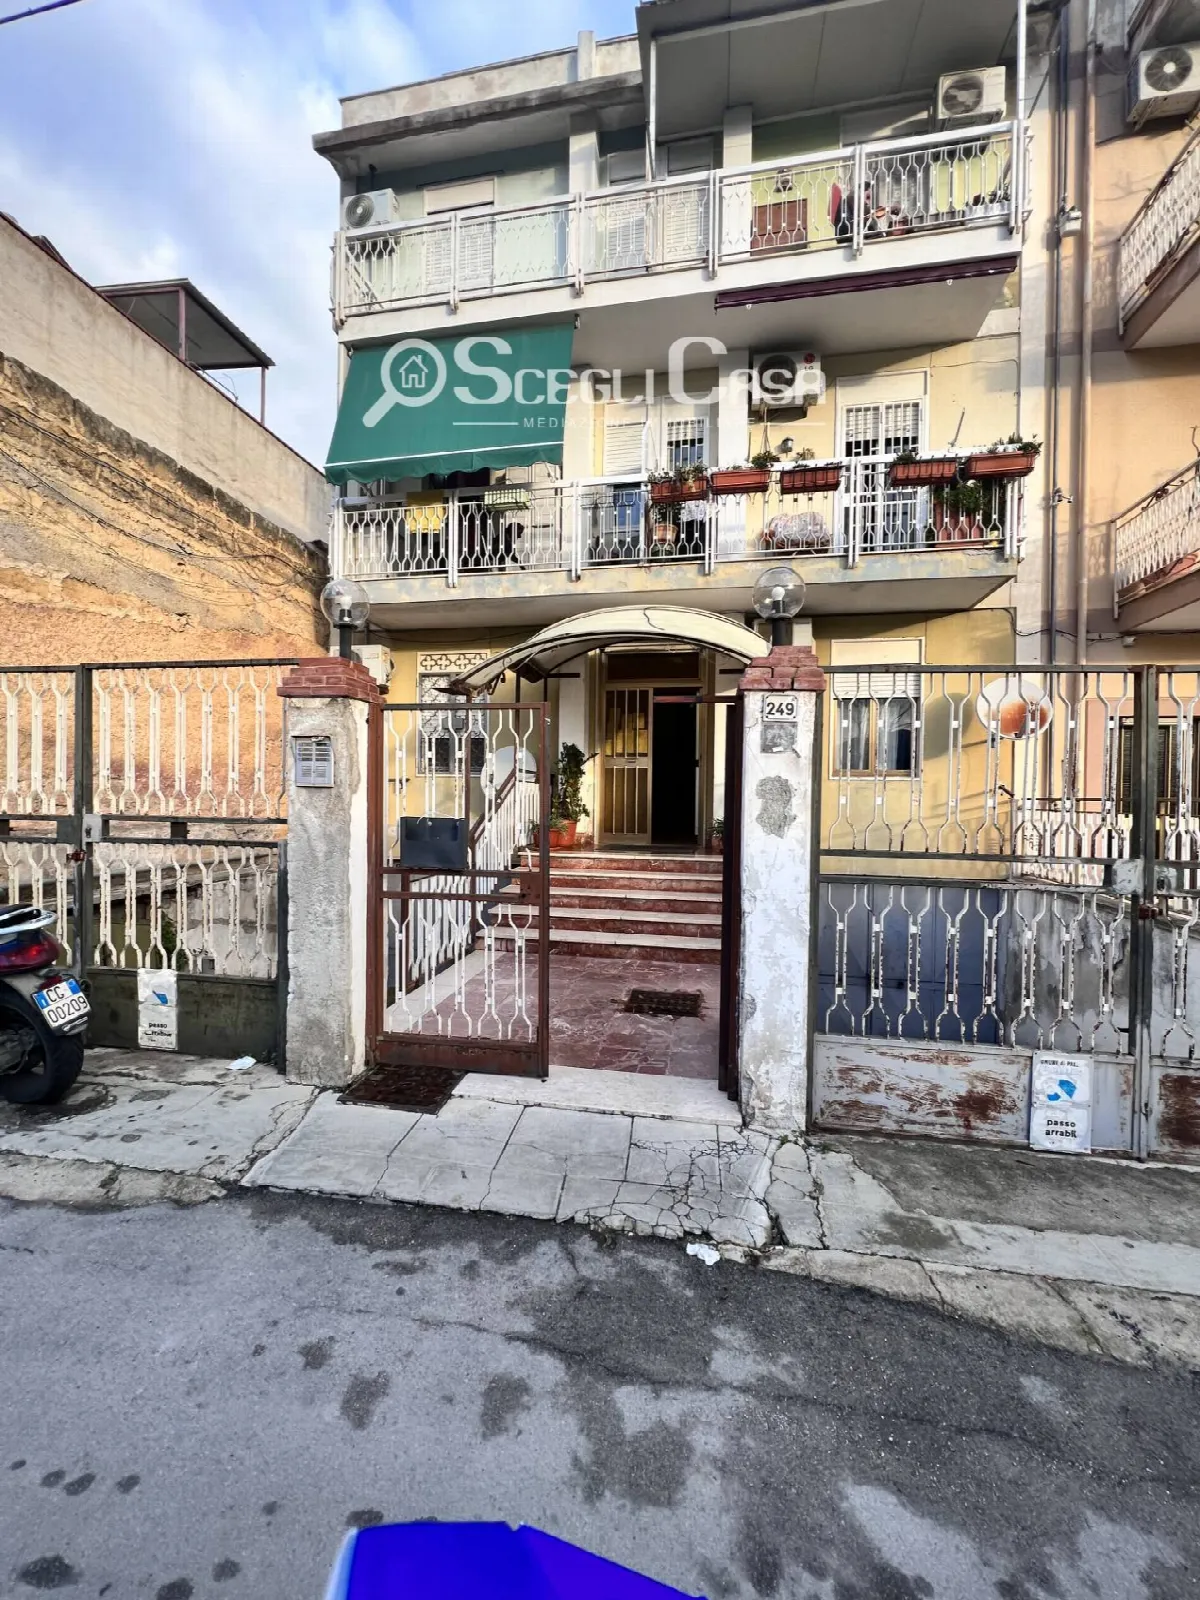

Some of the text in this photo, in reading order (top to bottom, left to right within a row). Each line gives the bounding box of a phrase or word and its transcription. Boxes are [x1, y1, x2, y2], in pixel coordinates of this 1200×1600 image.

[766, 702, 795, 716] 249
[45, 985, 65, 1003] CG
[47, 995, 88, 1023] 00209
[1047, 1119, 1076, 1128] passo
